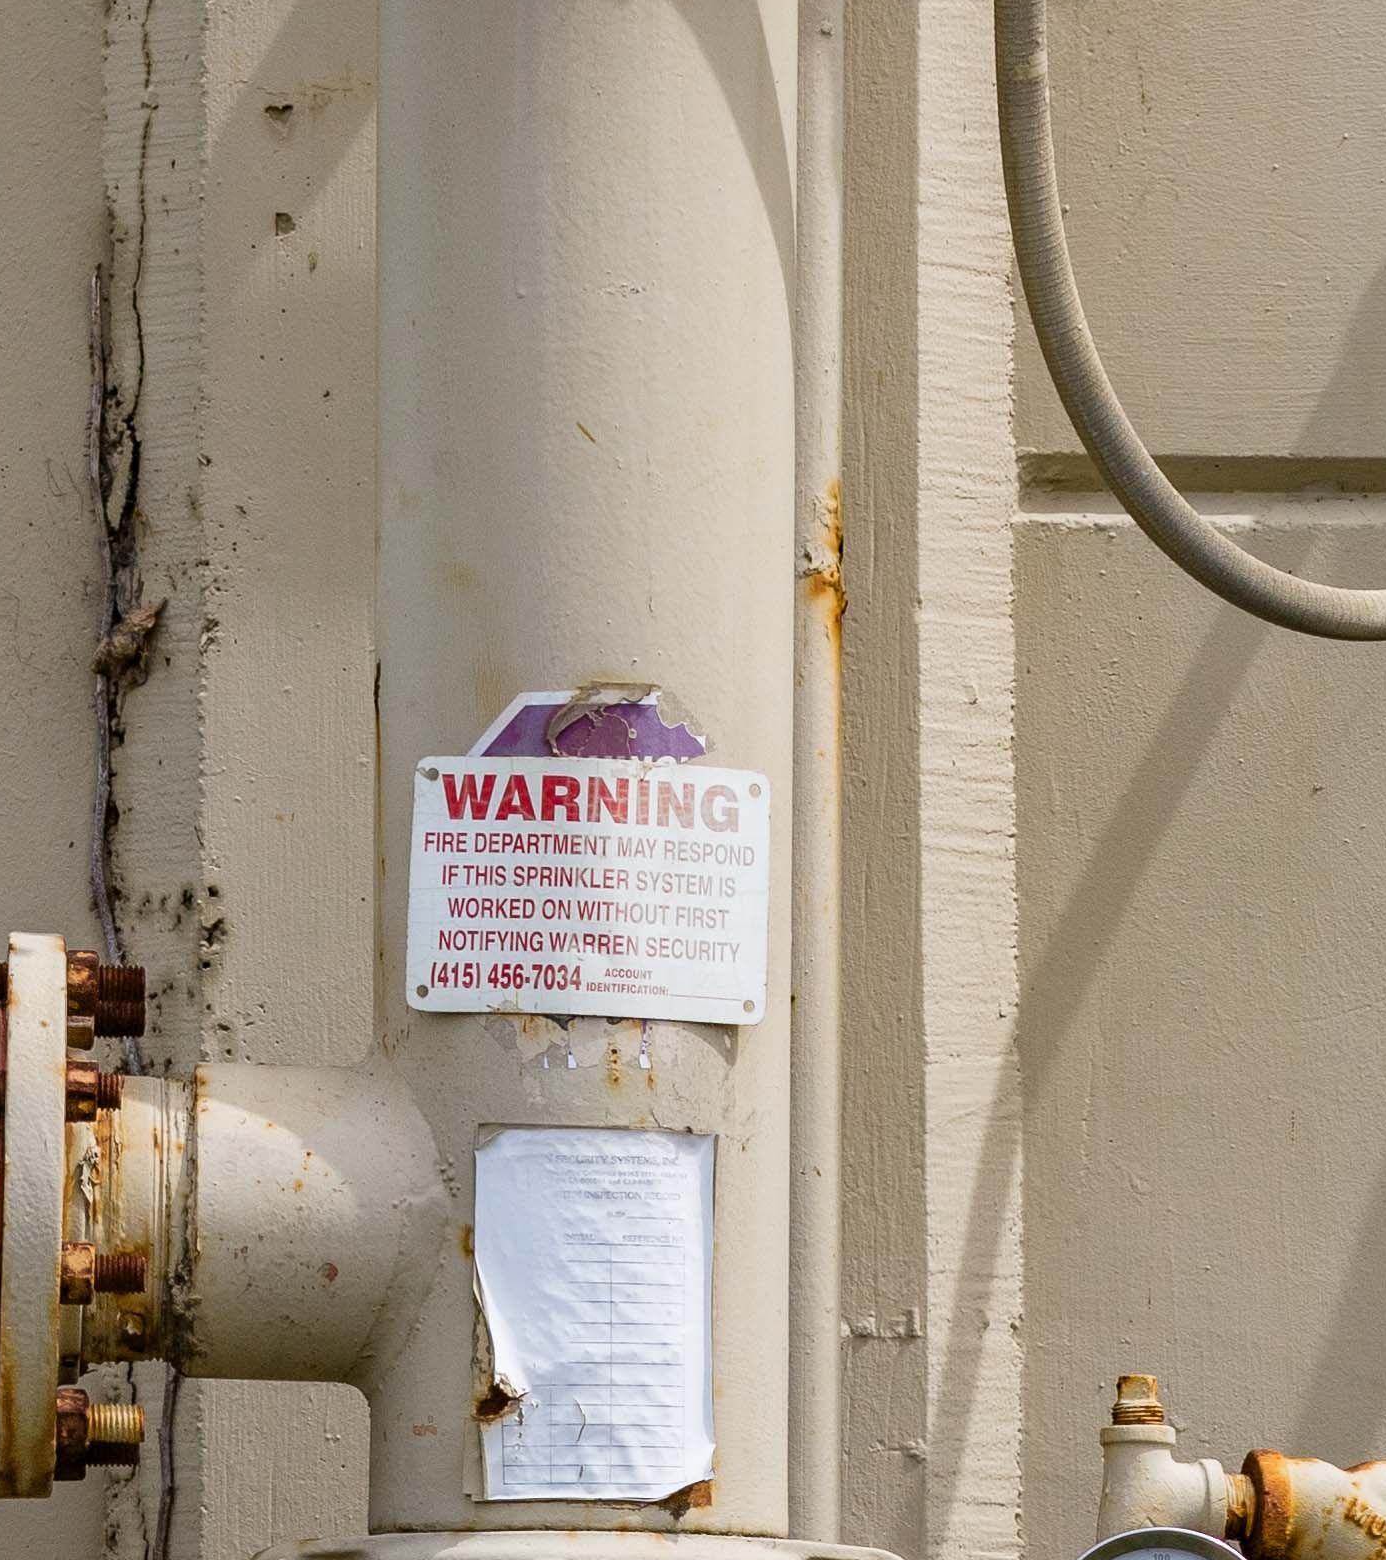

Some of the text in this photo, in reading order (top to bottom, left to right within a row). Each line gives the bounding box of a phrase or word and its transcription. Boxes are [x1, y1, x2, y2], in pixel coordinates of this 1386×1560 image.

[441, 773, 739, 832] WARNING
[424, 832, 755, 866] FIRE DEPARTMENT MAY RESPOND
[442, 865, 735, 897] IF THIS SPRINKLER SYSTEM IS
[448, 898, 729, 928] WORKED ON WITHOUT FIRST
[439, 931, 741, 962] NOTIFYING WARREN SECURITY
[430, 962, 582, 990] (415) 456-7034
[605, 968, 652, 979] ACCOUNT
[586, 983, 669, 996] IDENTIFICATION:
